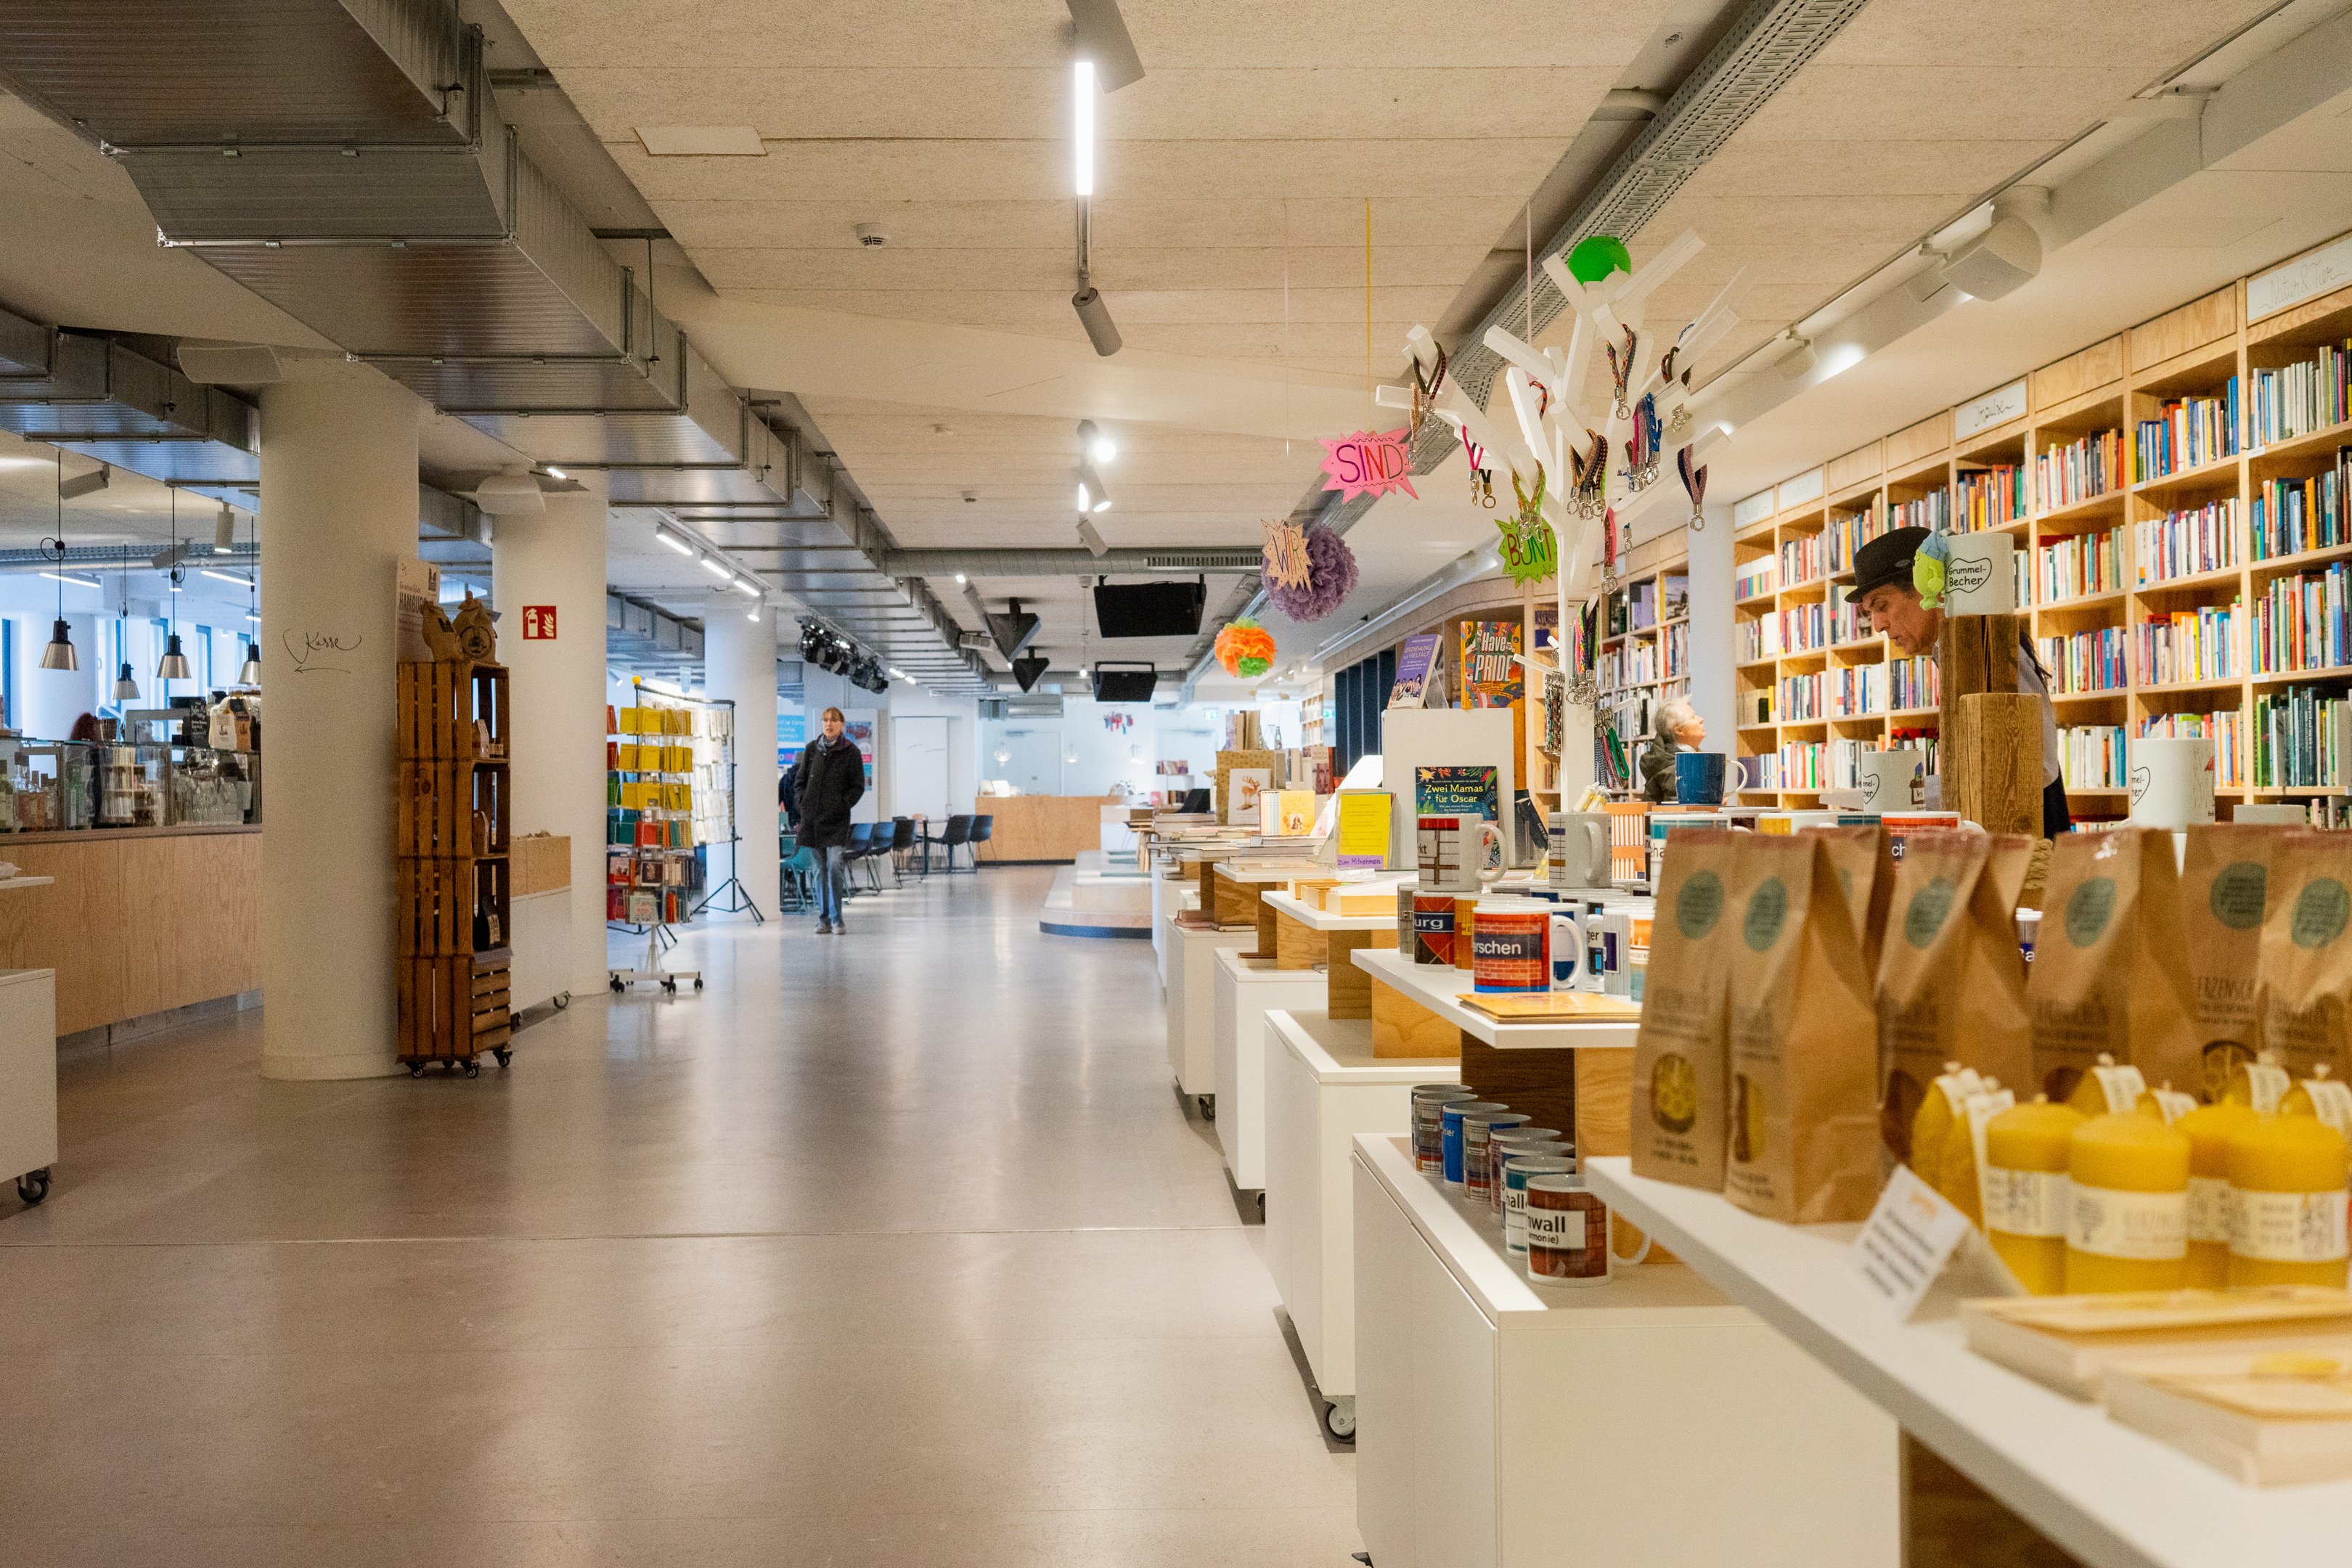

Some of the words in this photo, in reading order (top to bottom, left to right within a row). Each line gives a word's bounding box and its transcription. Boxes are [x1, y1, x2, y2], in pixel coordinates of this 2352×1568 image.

[1336, 444, 1404, 483] SIND
[1273, 528, 1303, 579] WIR
[1506, 528, 1553, 566] BUNT
[1948, 565, 1987, 576] Grummel-
[1948, 576, 1983, 587] Becher
[1481, 632, 1507, 652] Have
[1474, 654, 1514, 682] PRIDE
[1425, 784, 1448, 793] Zwei
[1450, 784, 1484, 793] Mamas
[1434, 793, 1448, 803] für
[1450, 794, 1477, 803] Oscar
[1414, 918, 1444, 930] urg
